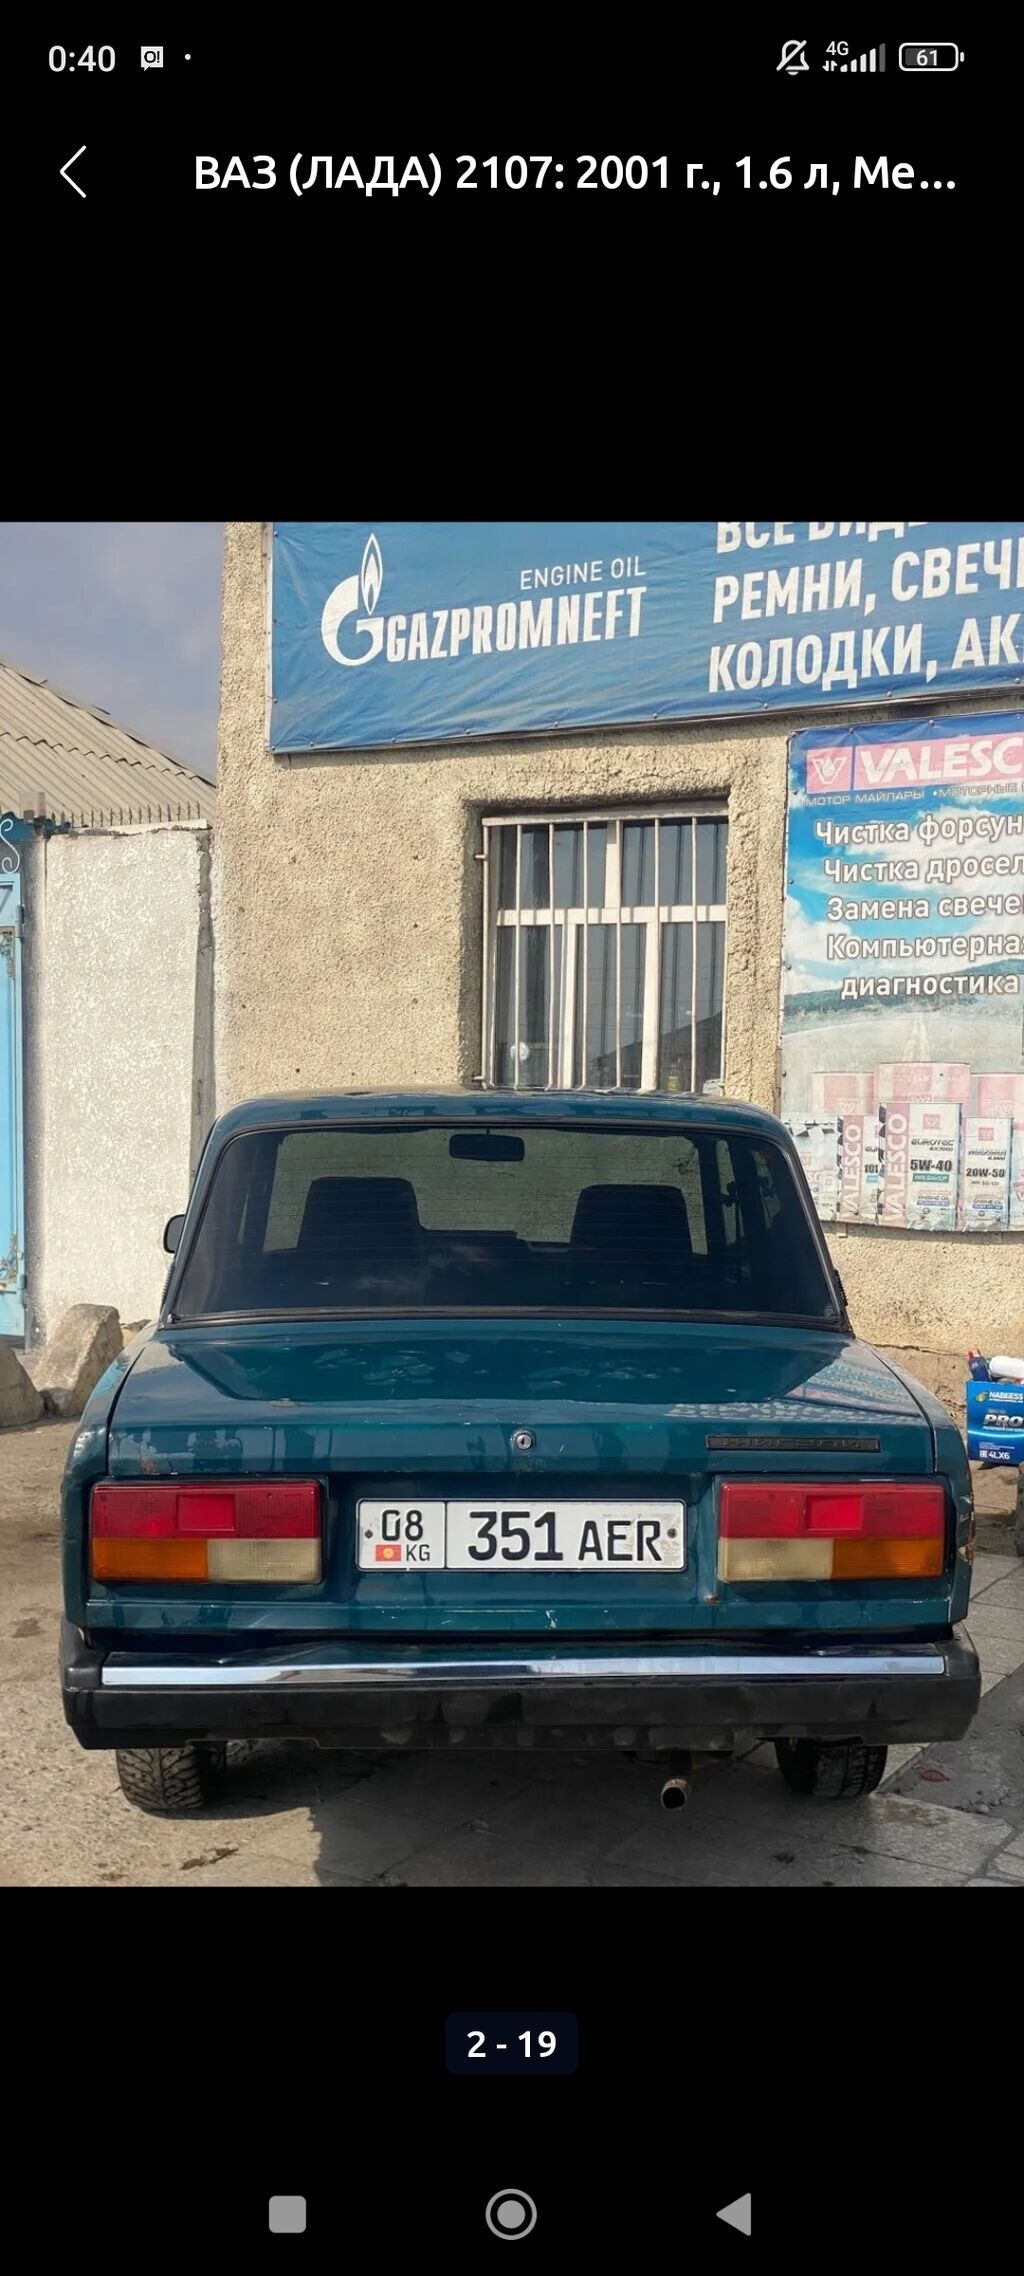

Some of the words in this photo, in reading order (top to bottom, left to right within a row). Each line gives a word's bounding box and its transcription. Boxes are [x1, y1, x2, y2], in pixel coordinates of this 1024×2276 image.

[520, 560, 603, 590] ENGINE
[610, 556, 647, 580] OIL
[713, 558, 876, 624] РЕМНИ,
[386, 586, 647, 663] GAZPROMNEFT
[708, 623, 937, 693] КОЛОДКИ,
[860, 737, 1024, 784] VALESC
[805, 795, 851, 806] МОТОР
[855, 790, 925, 805] МАЙЛАРЫ
[816, 820, 911, 846] Чистка
[918, 813, 1024, 847] форсун
[824, 858, 920, 883] Чистка
[827, 896, 930, 922] Замена
[938, 893, 1024, 918] свече
[841, 974, 1020, 1001] диагностика
[842, 1124, 862, 1216] VALESCO
[885, 1112, 908, 1218] VALESCO
[910, 1159, 953, 1173] 5W-40
[966, 1167, 1006, 1178] 20W-50
[983, 1414, 1024, 1427] PRO
[381, 1509, 424, 1542] 08
[468, 1511, 564, 1562] 351
[578, 1520, 662, 1562] AER
[405, 1544, 430, 1562] KG
